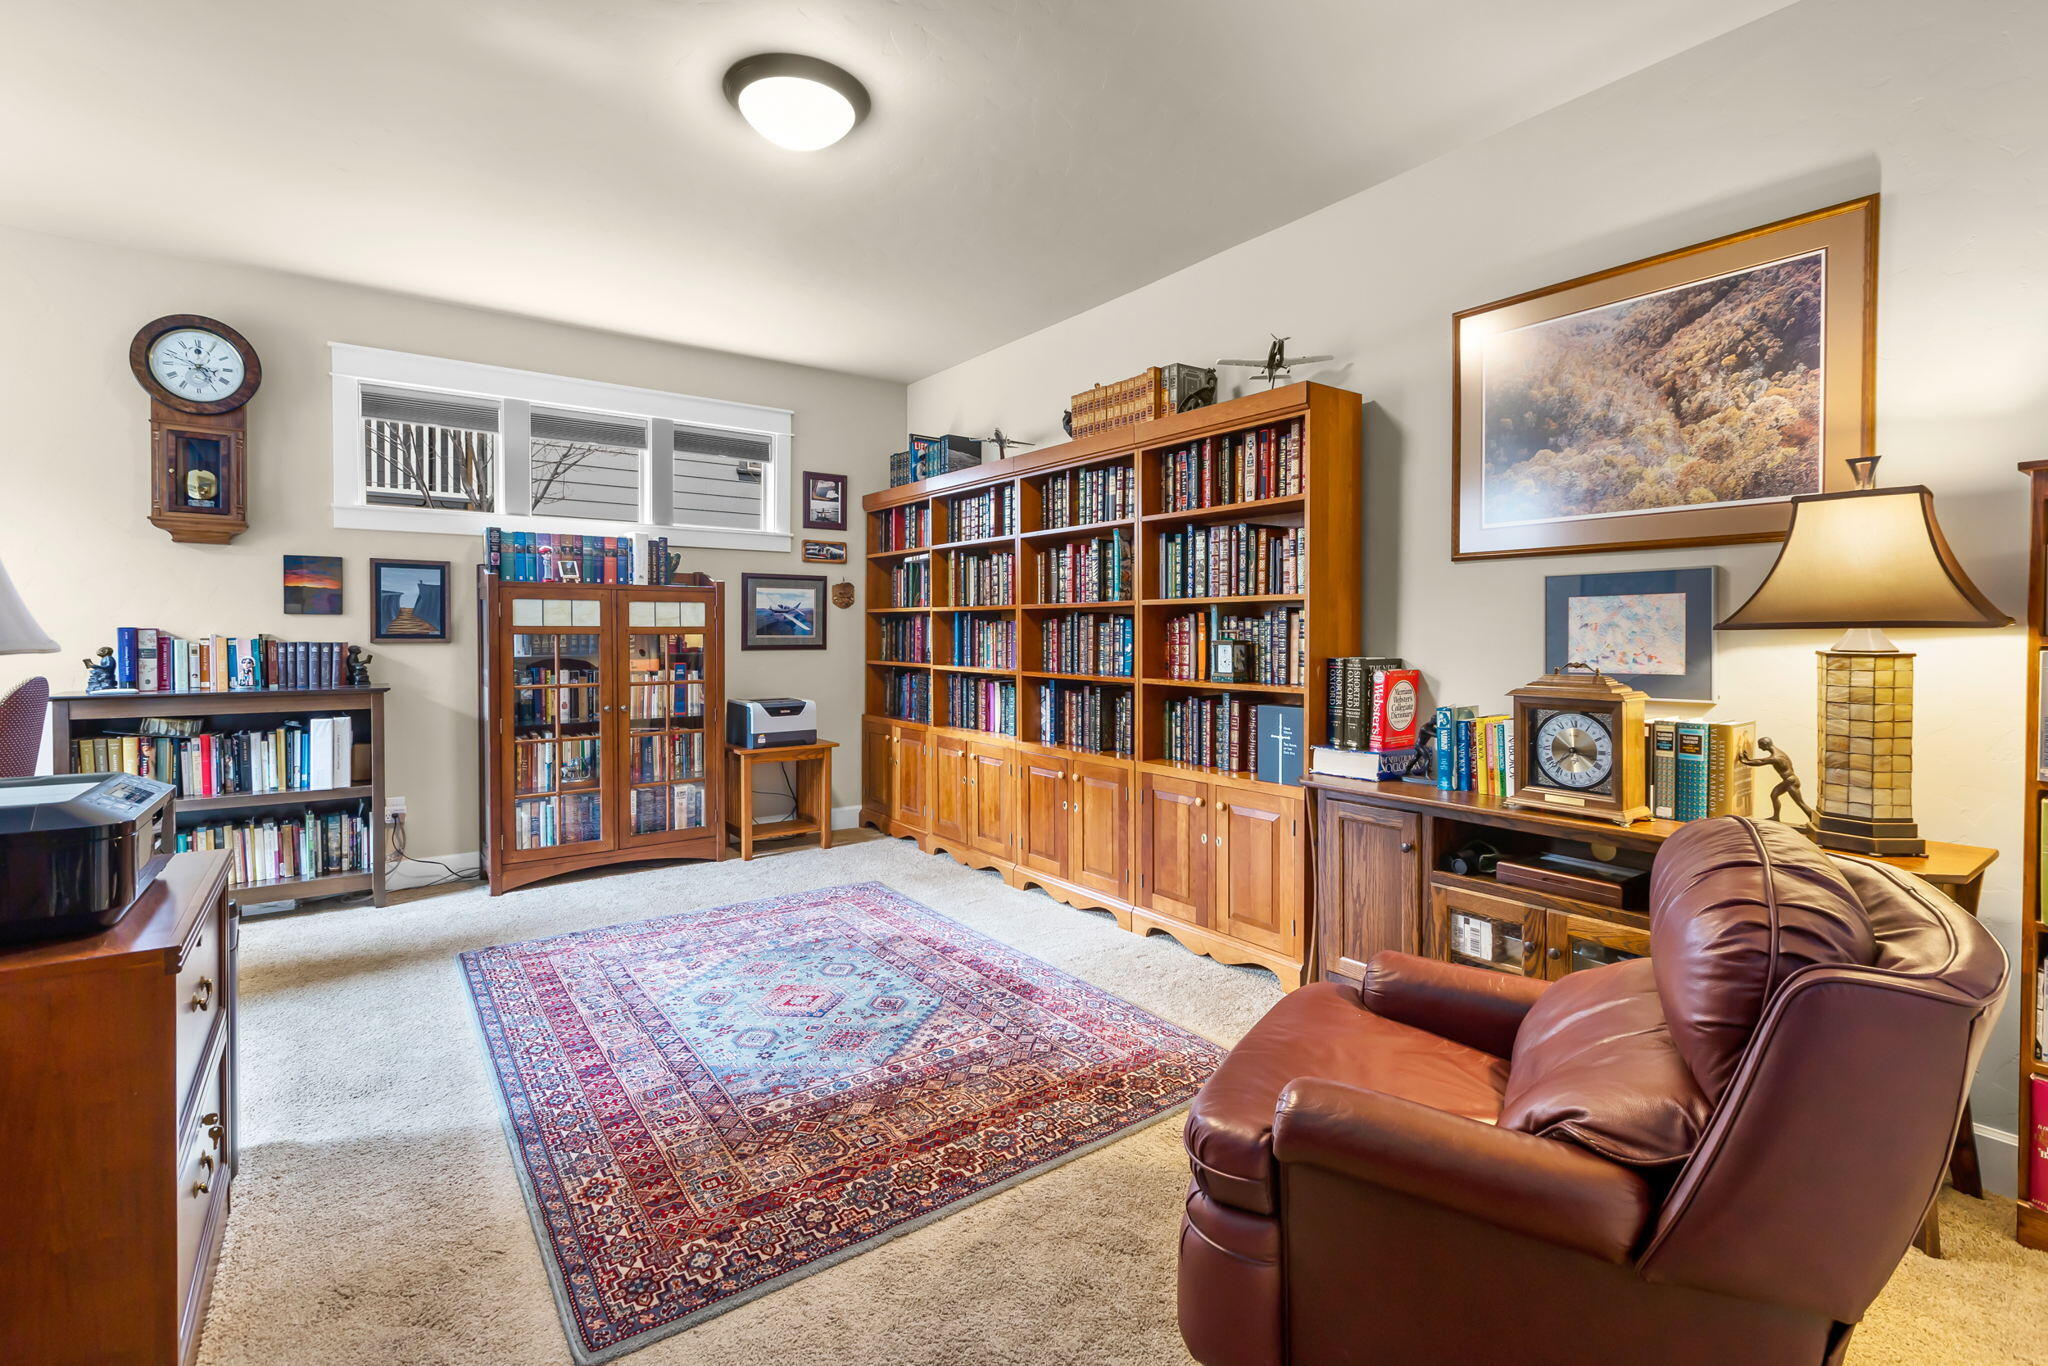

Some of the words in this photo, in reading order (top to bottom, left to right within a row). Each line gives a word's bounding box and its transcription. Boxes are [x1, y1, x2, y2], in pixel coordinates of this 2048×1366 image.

[1346, 670, 1354, 708] OXFORD
[1372, 683, 1384, 734] Webster's
[1719, 773, 1725, 782] TO
